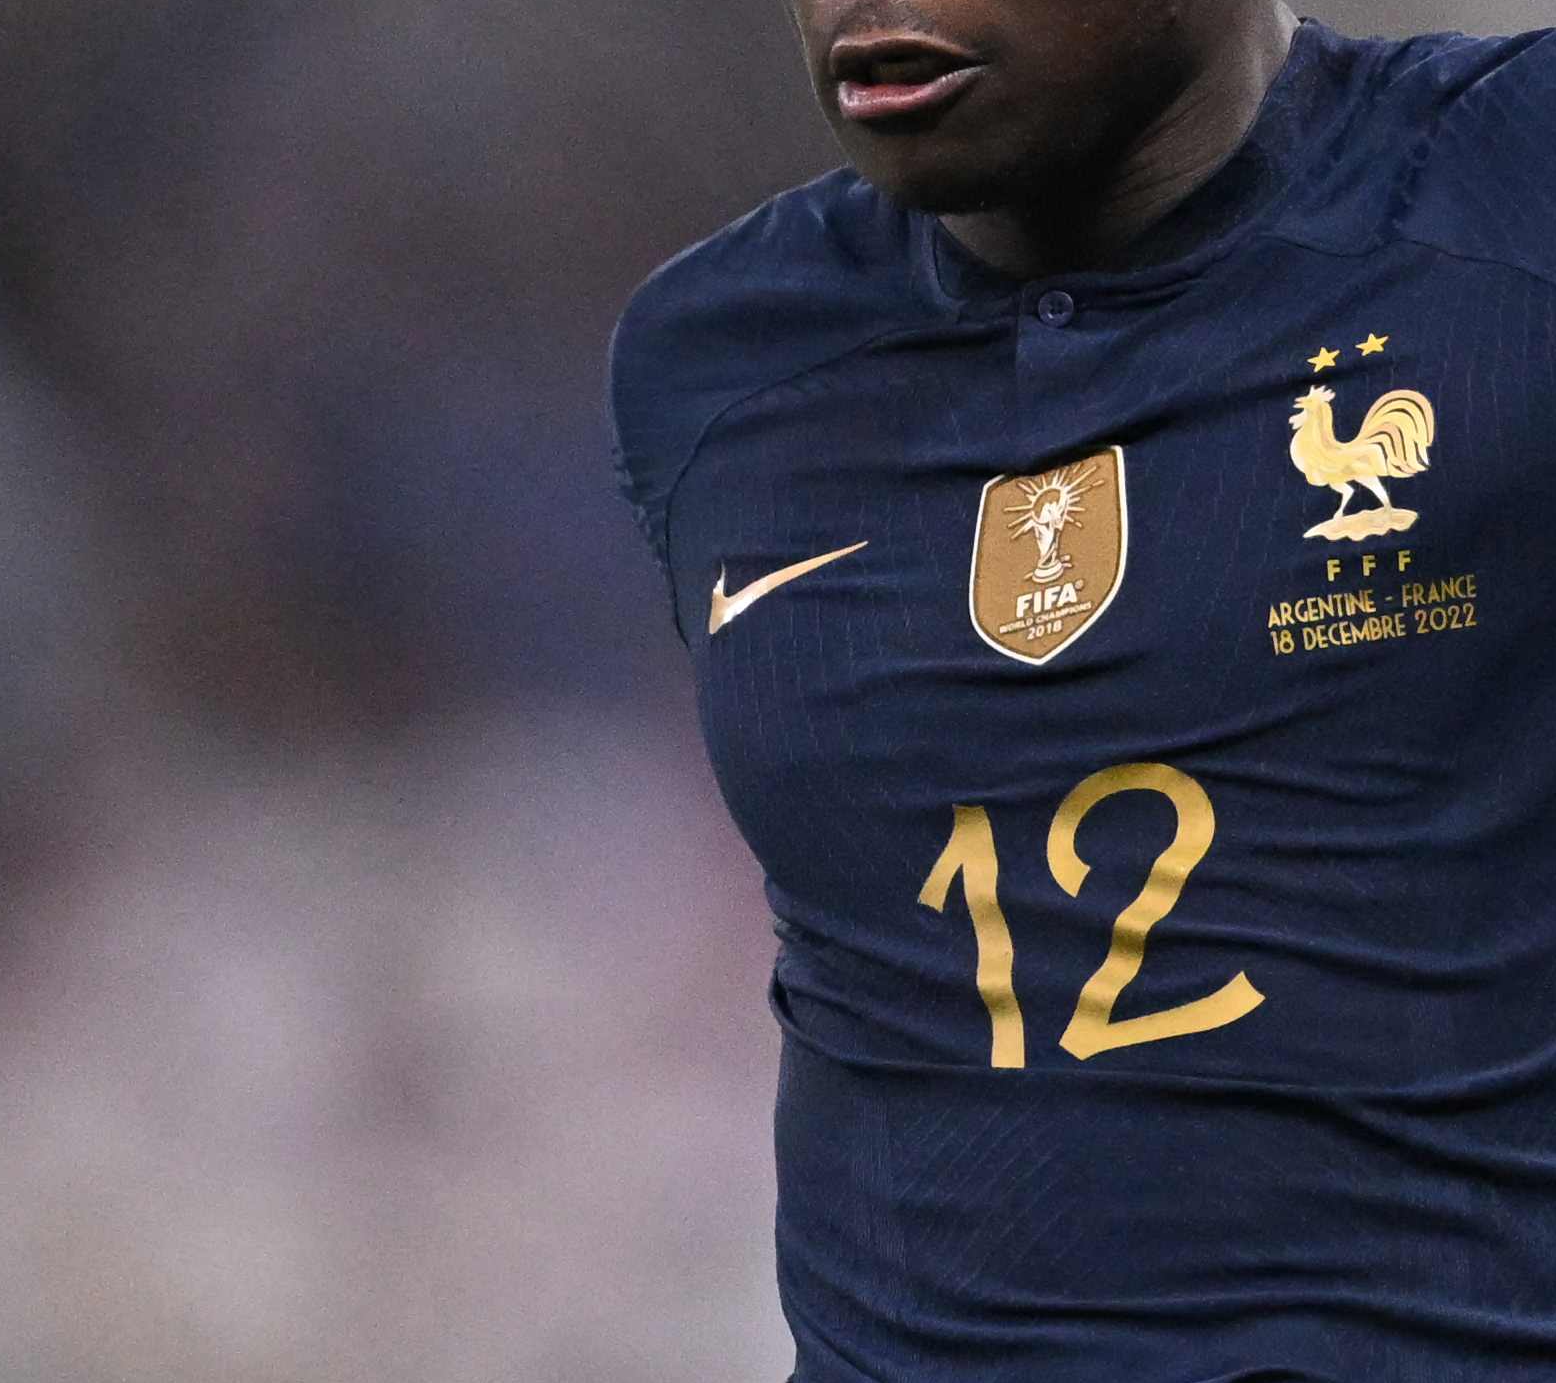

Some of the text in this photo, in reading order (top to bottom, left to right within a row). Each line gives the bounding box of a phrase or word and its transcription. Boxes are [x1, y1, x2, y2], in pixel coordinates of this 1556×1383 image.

[1268, 589, 1377, 628] ARGENTINE
[1401, 574, 1478, 608] FRANCE
[1026, 619, 1064, 641] 2018
[1270, 602, 1478, 657] 18 DECEMBRE 2022
[917, 762, 1266, 1069] 12
